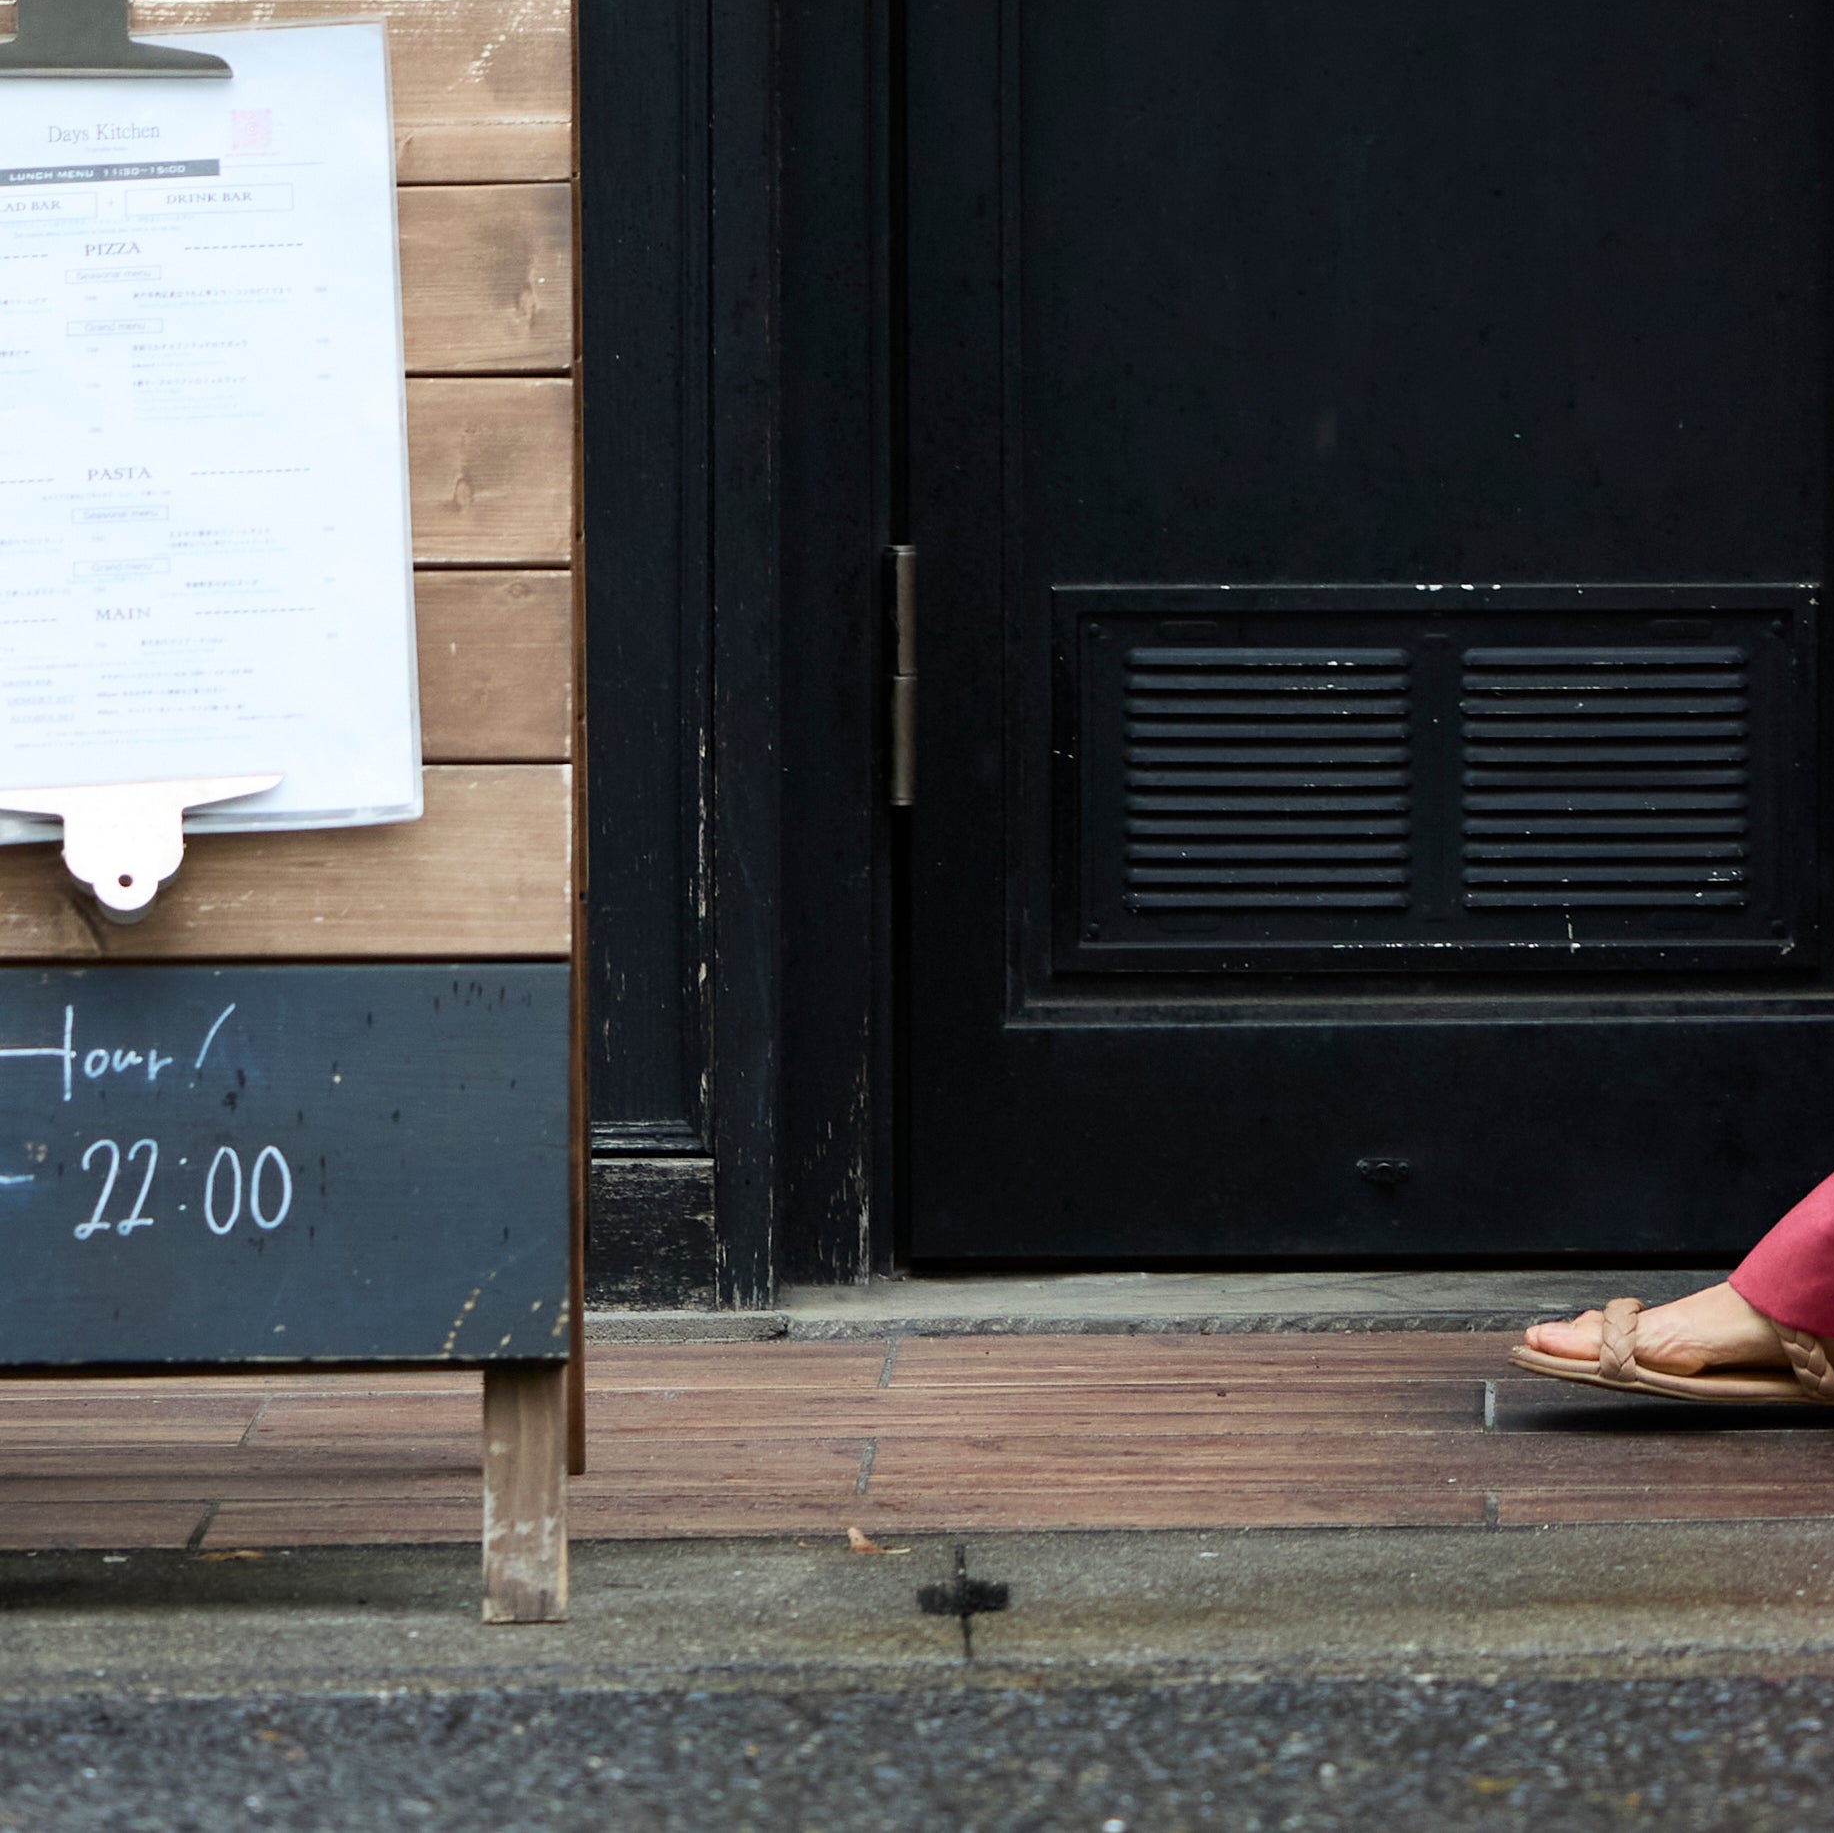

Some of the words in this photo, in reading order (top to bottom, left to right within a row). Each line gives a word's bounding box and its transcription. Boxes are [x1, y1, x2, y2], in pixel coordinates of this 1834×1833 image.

[48, 124, 90, 145] Days
[96, 122, 161, 142] Kitchen
[9, 171, 53, 182] LUNCH
[57, 169, 94, 180] MENU
[31, 199, 62, 211] BAR
[166, 193, 218, 204] DRINK
[222, 191, 253, 203] BAR
[84, 241, 142, 257] PIZZA
[87, 466, 152, 482] PASTA
[95, 606, 152, 622] MAIN
[73, 1138, 293, 1240] 22:00
